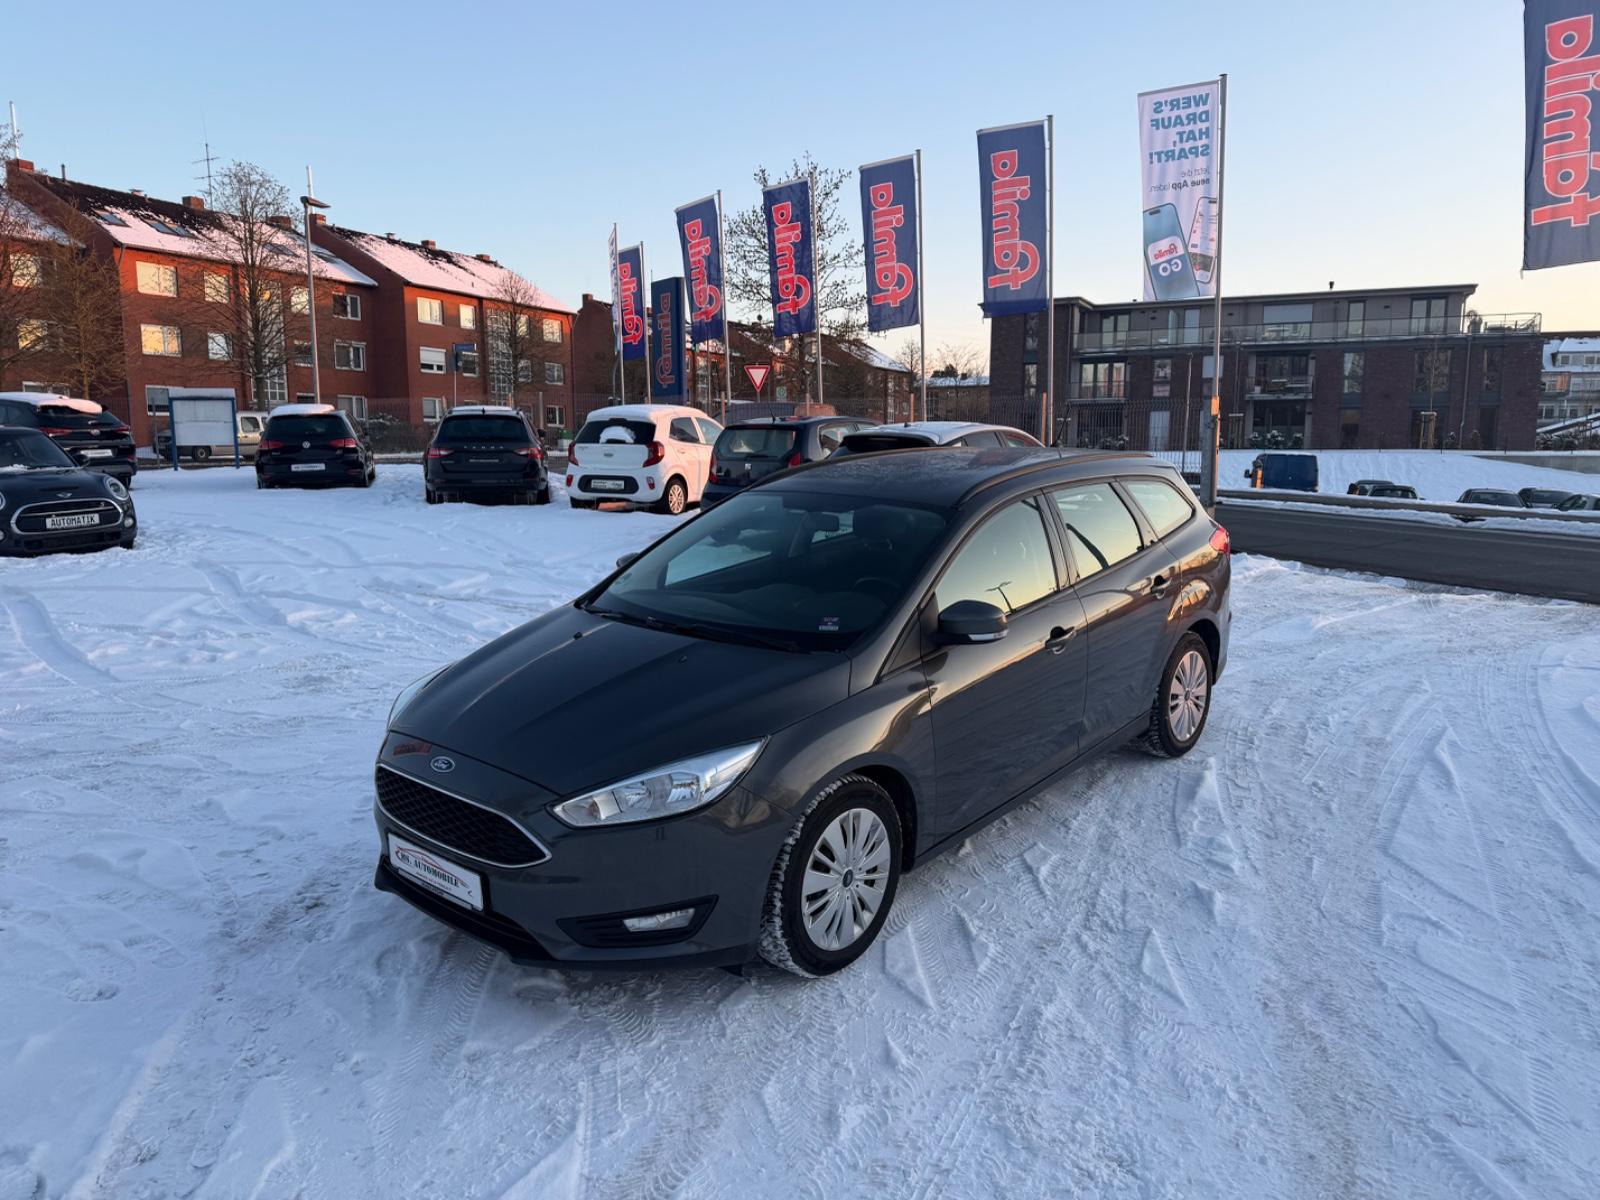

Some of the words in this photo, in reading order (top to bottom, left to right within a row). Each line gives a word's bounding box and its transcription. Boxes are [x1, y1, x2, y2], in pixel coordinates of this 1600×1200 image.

[656, 292, 676, 389] famila
[51, 514, 95, 528] AUTOMATIK
[414, 859, 459, 887] AUTOMOBILE
